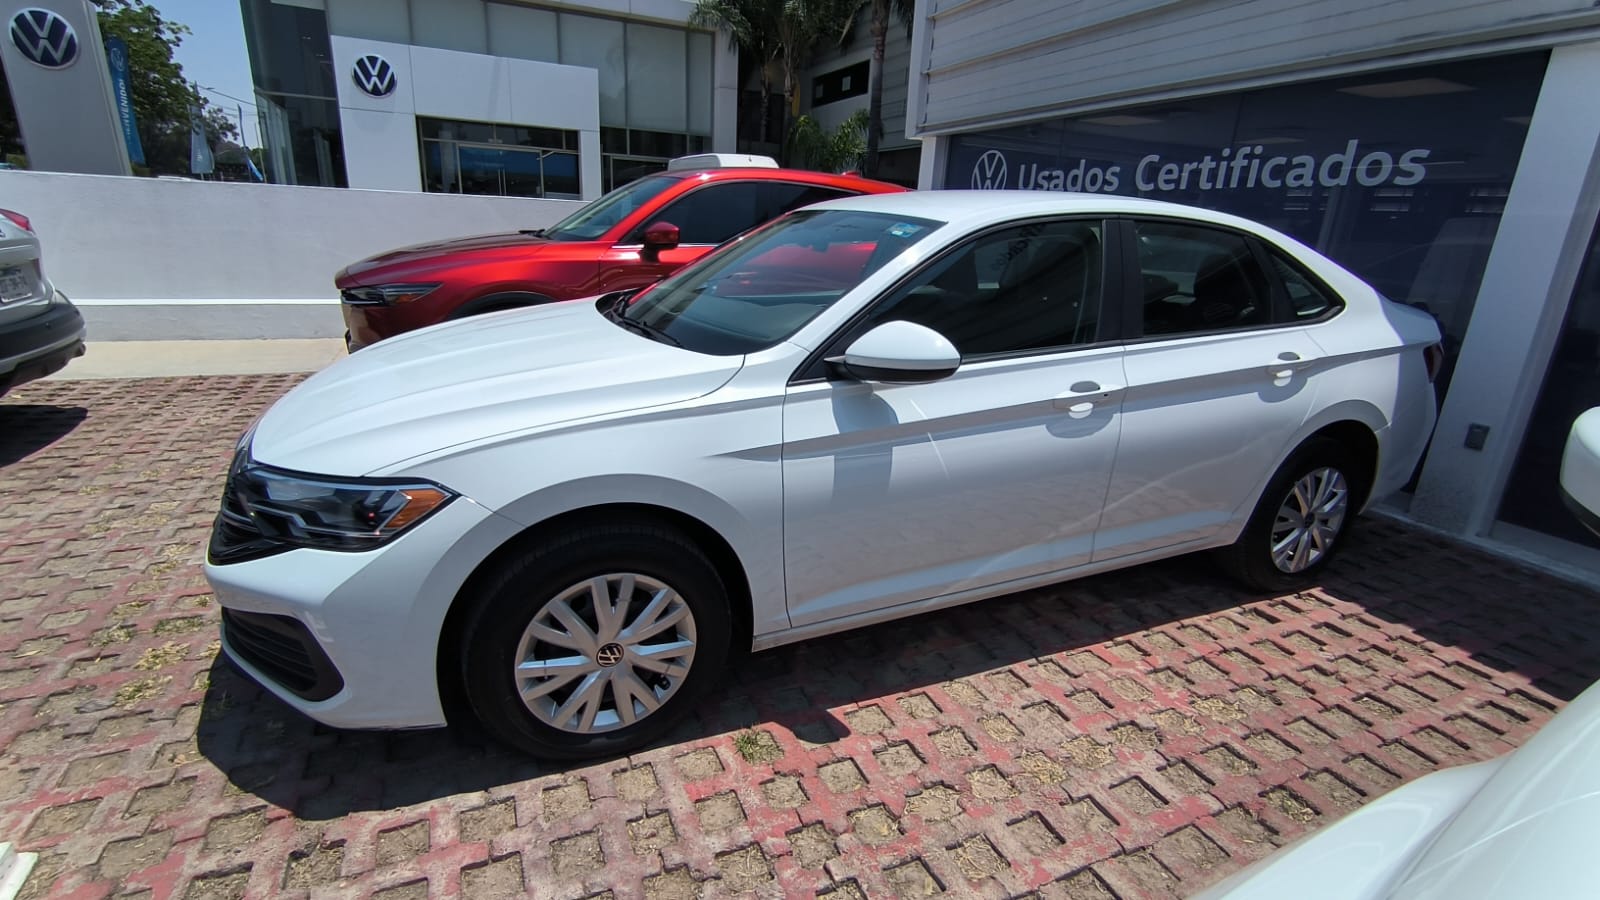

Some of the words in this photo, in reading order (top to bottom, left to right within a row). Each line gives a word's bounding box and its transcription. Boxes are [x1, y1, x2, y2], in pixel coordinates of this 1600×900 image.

[9, 8, 78, 69] VW
[352, 54, 395, 96] VW
[1018, 159, 1120, 193] Usados
[1135, 139, 1431, 191] Certificados
